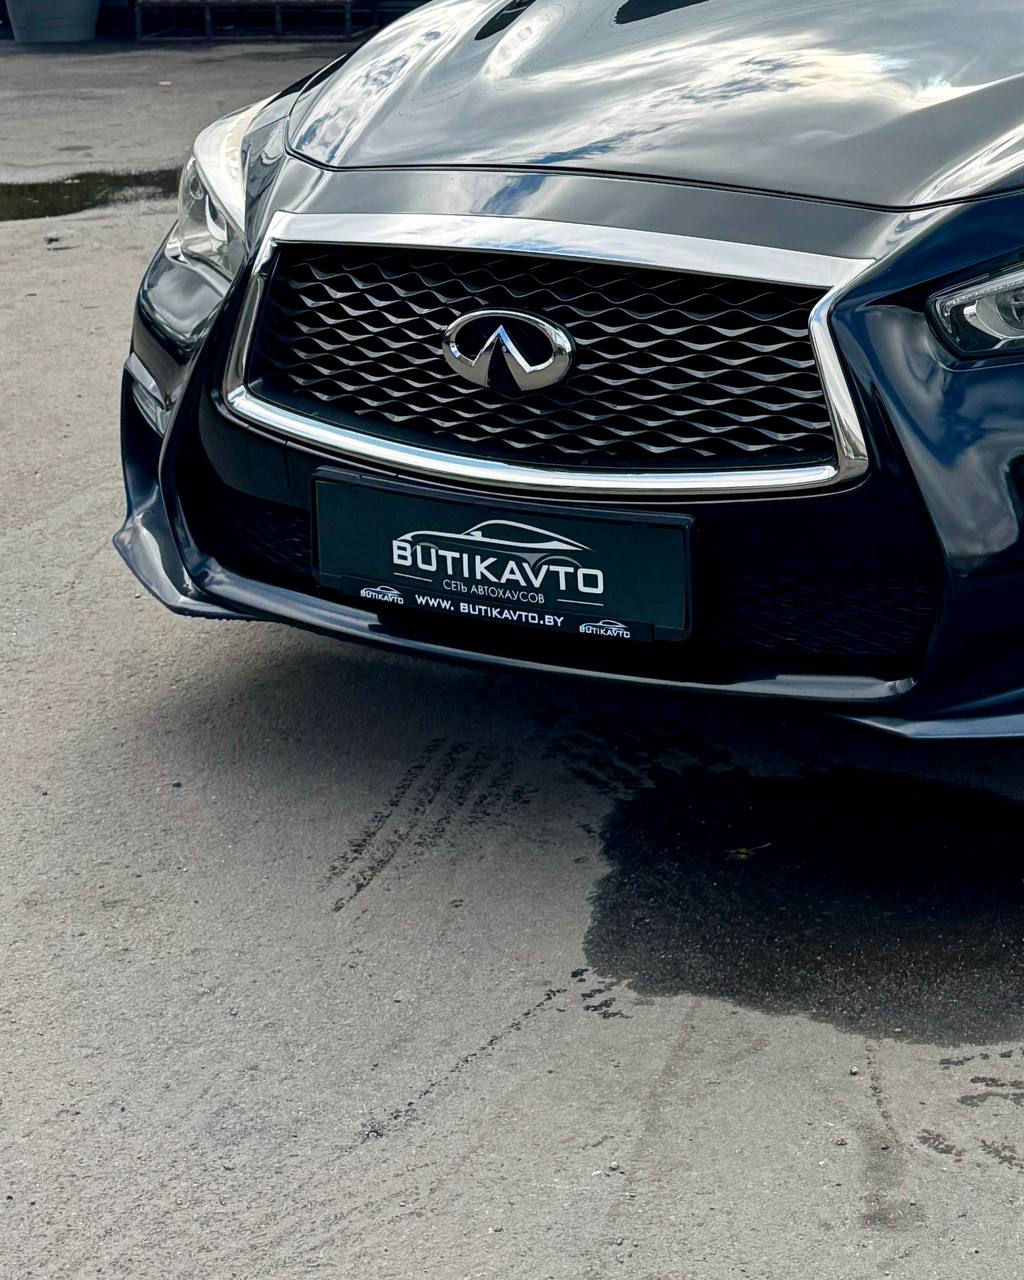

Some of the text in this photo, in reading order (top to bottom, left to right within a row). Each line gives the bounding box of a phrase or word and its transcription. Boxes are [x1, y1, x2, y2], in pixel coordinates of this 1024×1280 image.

[392, 538, 604, 595] BUTIKAVTO
[360, 589, 404, 605] BUTIKAVTO
[442, 579, 545, 604] СЕТЬ АВТОХАУСОВ
[415, 594, 564, 627] WWW. BUTIKAVTO.BY
[579, 625, 631, 639] BUTIKAVTO
